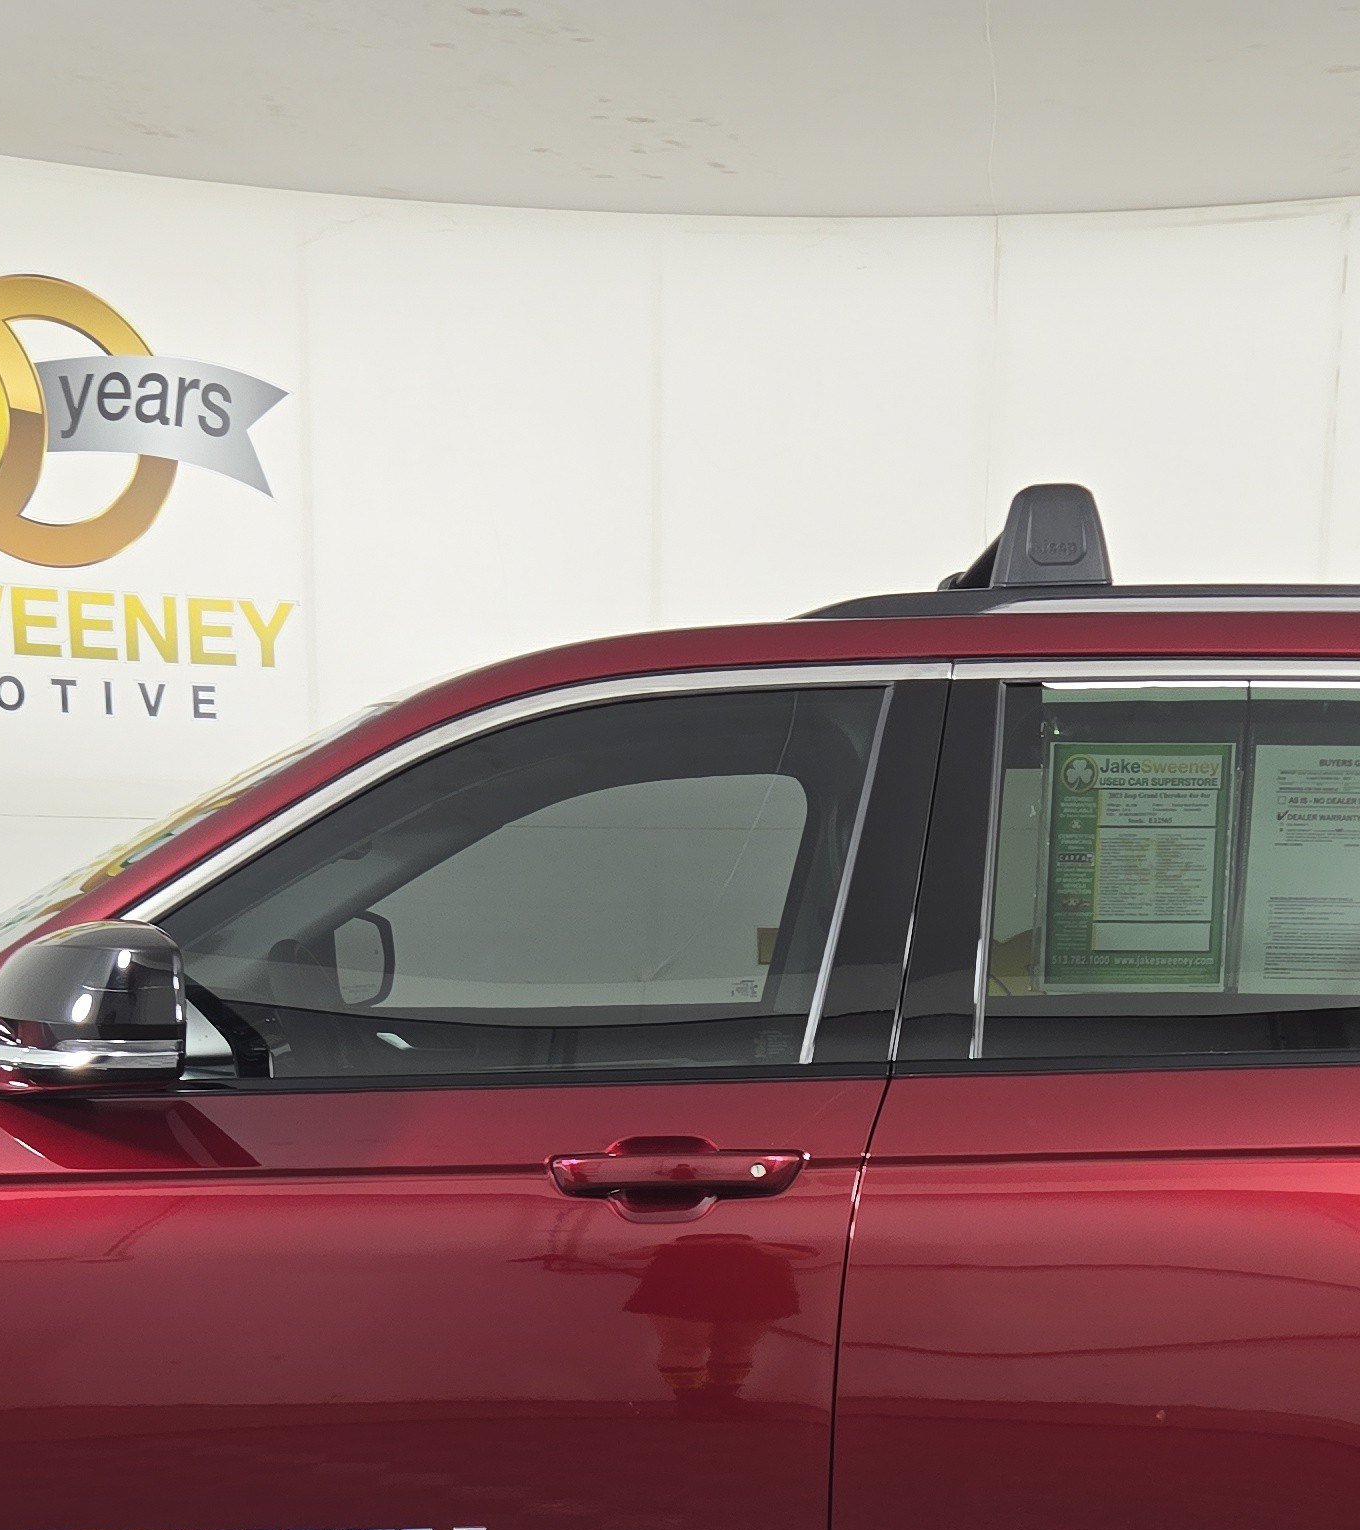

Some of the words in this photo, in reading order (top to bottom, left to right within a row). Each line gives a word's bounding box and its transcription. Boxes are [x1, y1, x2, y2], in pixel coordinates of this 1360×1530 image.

[59, 370, 233, 438] years
[1319, 759, 1353, 767] BUYERS
[1099, 777, 1126, 787] USED
[1128, 777, 1149, 787] CAR
[1150, 777, 1218, 787] SUPERSTORE
